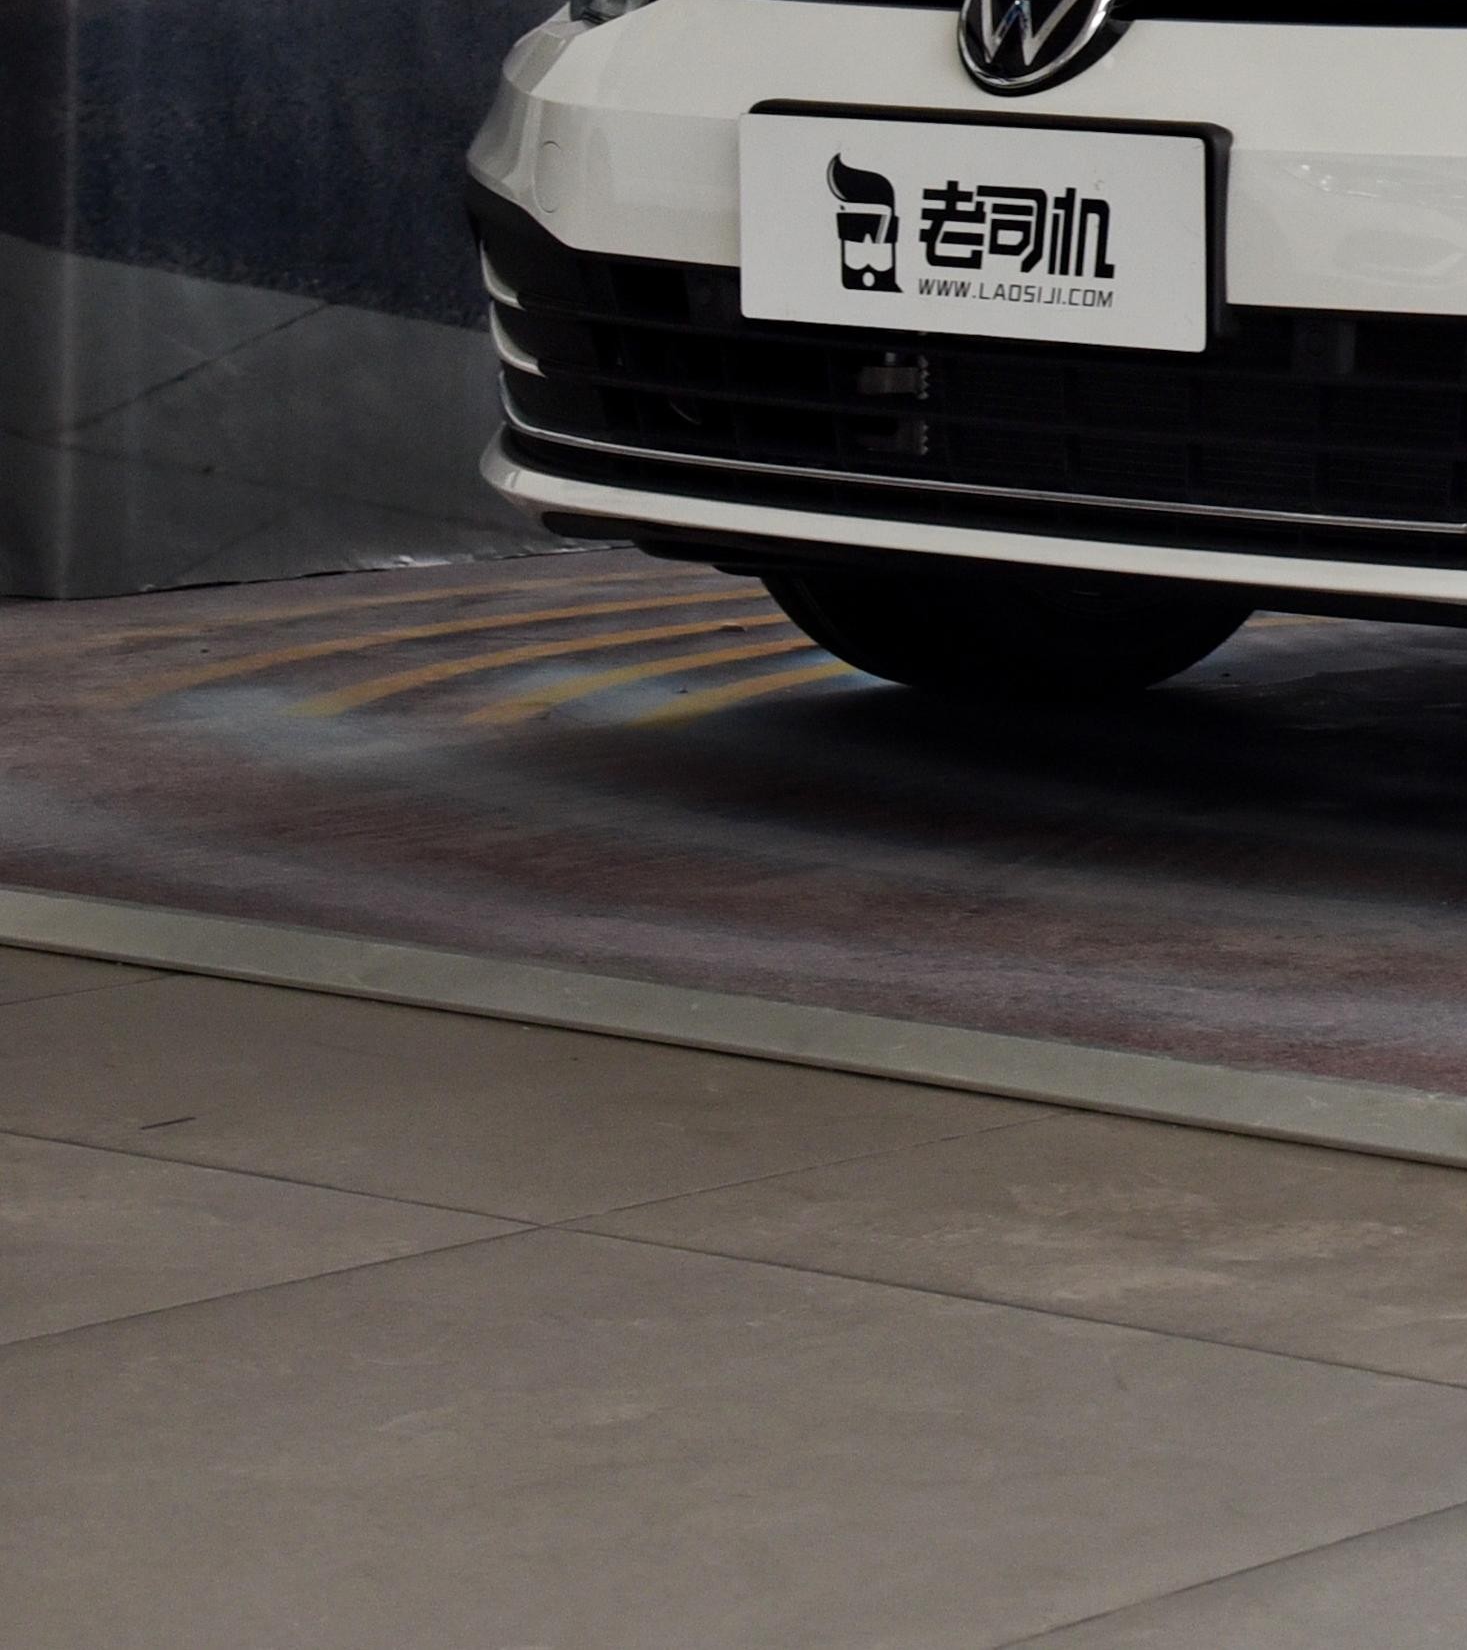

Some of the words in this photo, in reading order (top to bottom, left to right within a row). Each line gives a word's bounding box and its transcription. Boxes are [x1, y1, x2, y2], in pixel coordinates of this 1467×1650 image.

[918, 180, 1115, 278] 老司机
[918, 278, 1114, 308] WWW.LAOSIJI.COM
